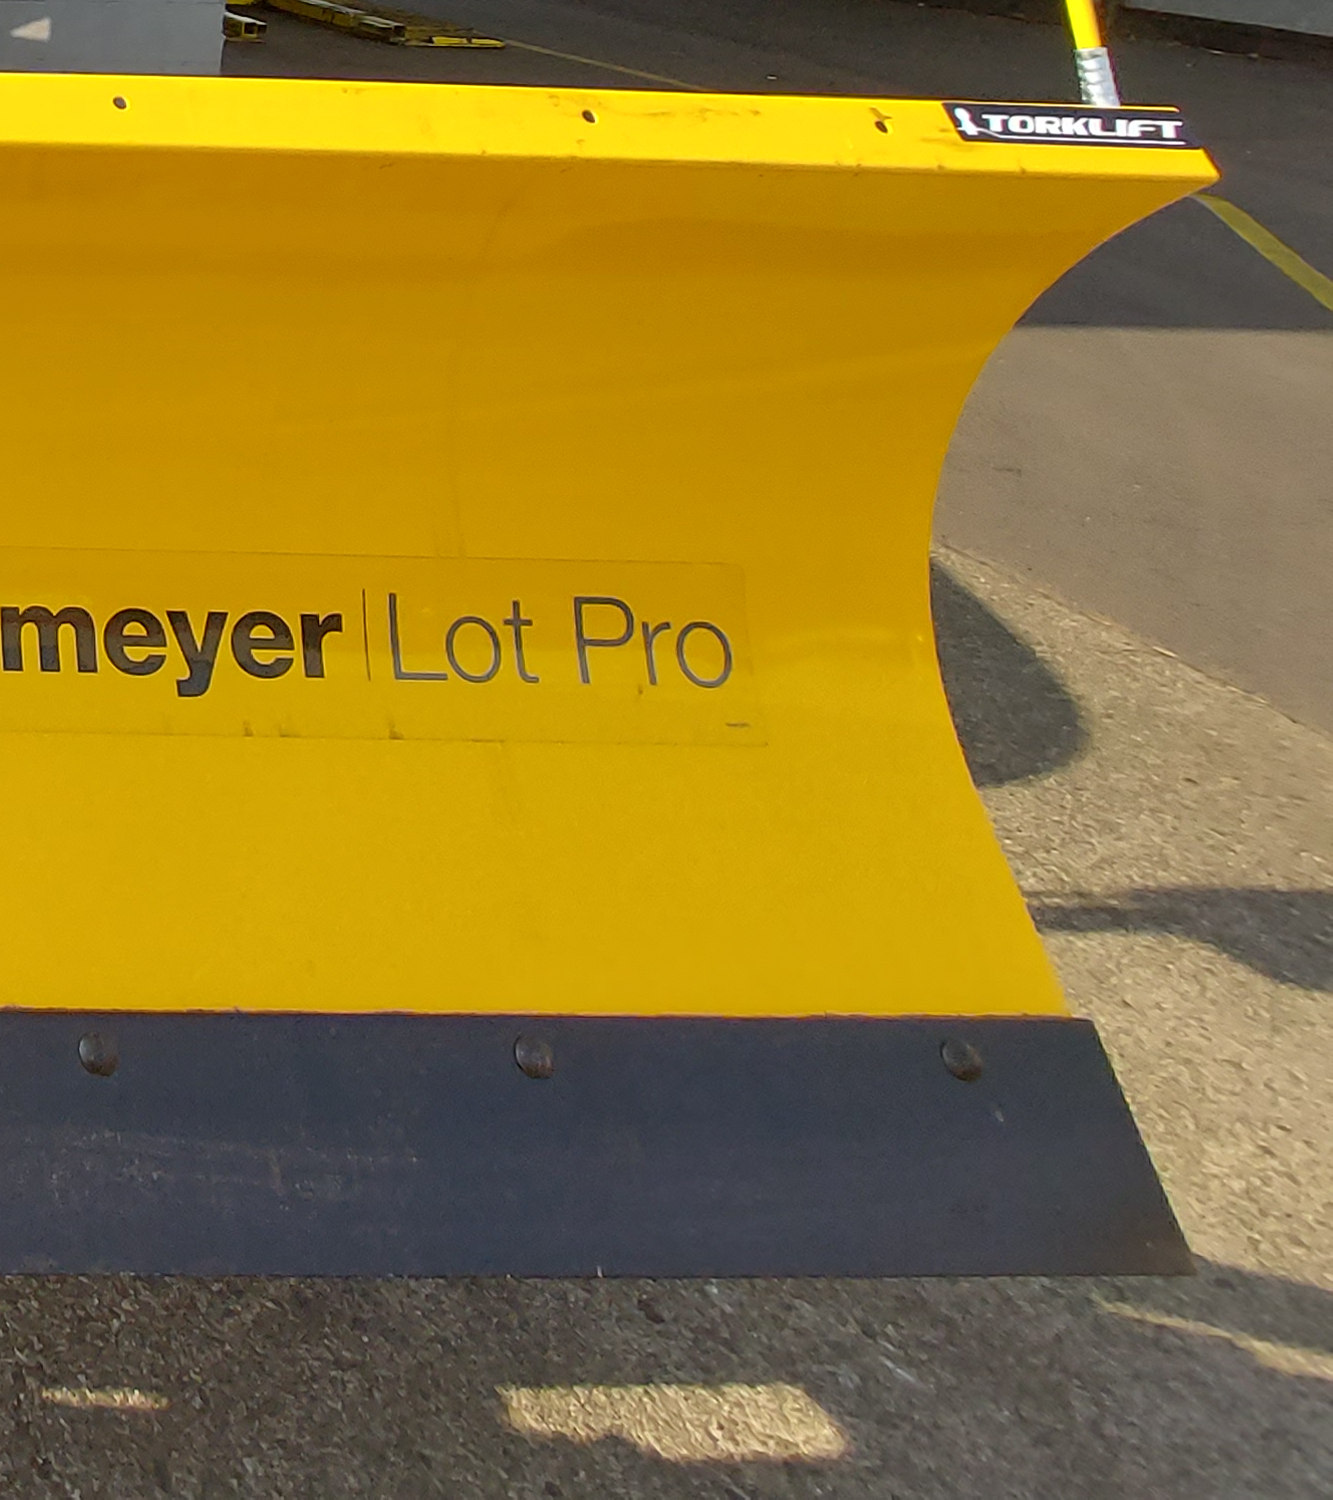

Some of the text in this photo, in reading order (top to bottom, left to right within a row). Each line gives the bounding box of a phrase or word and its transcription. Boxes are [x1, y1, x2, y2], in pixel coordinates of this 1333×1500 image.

[981, 113, 1183, 139] TORKLIFT
[0, 591, 733, 698] meyer Lot Pro
